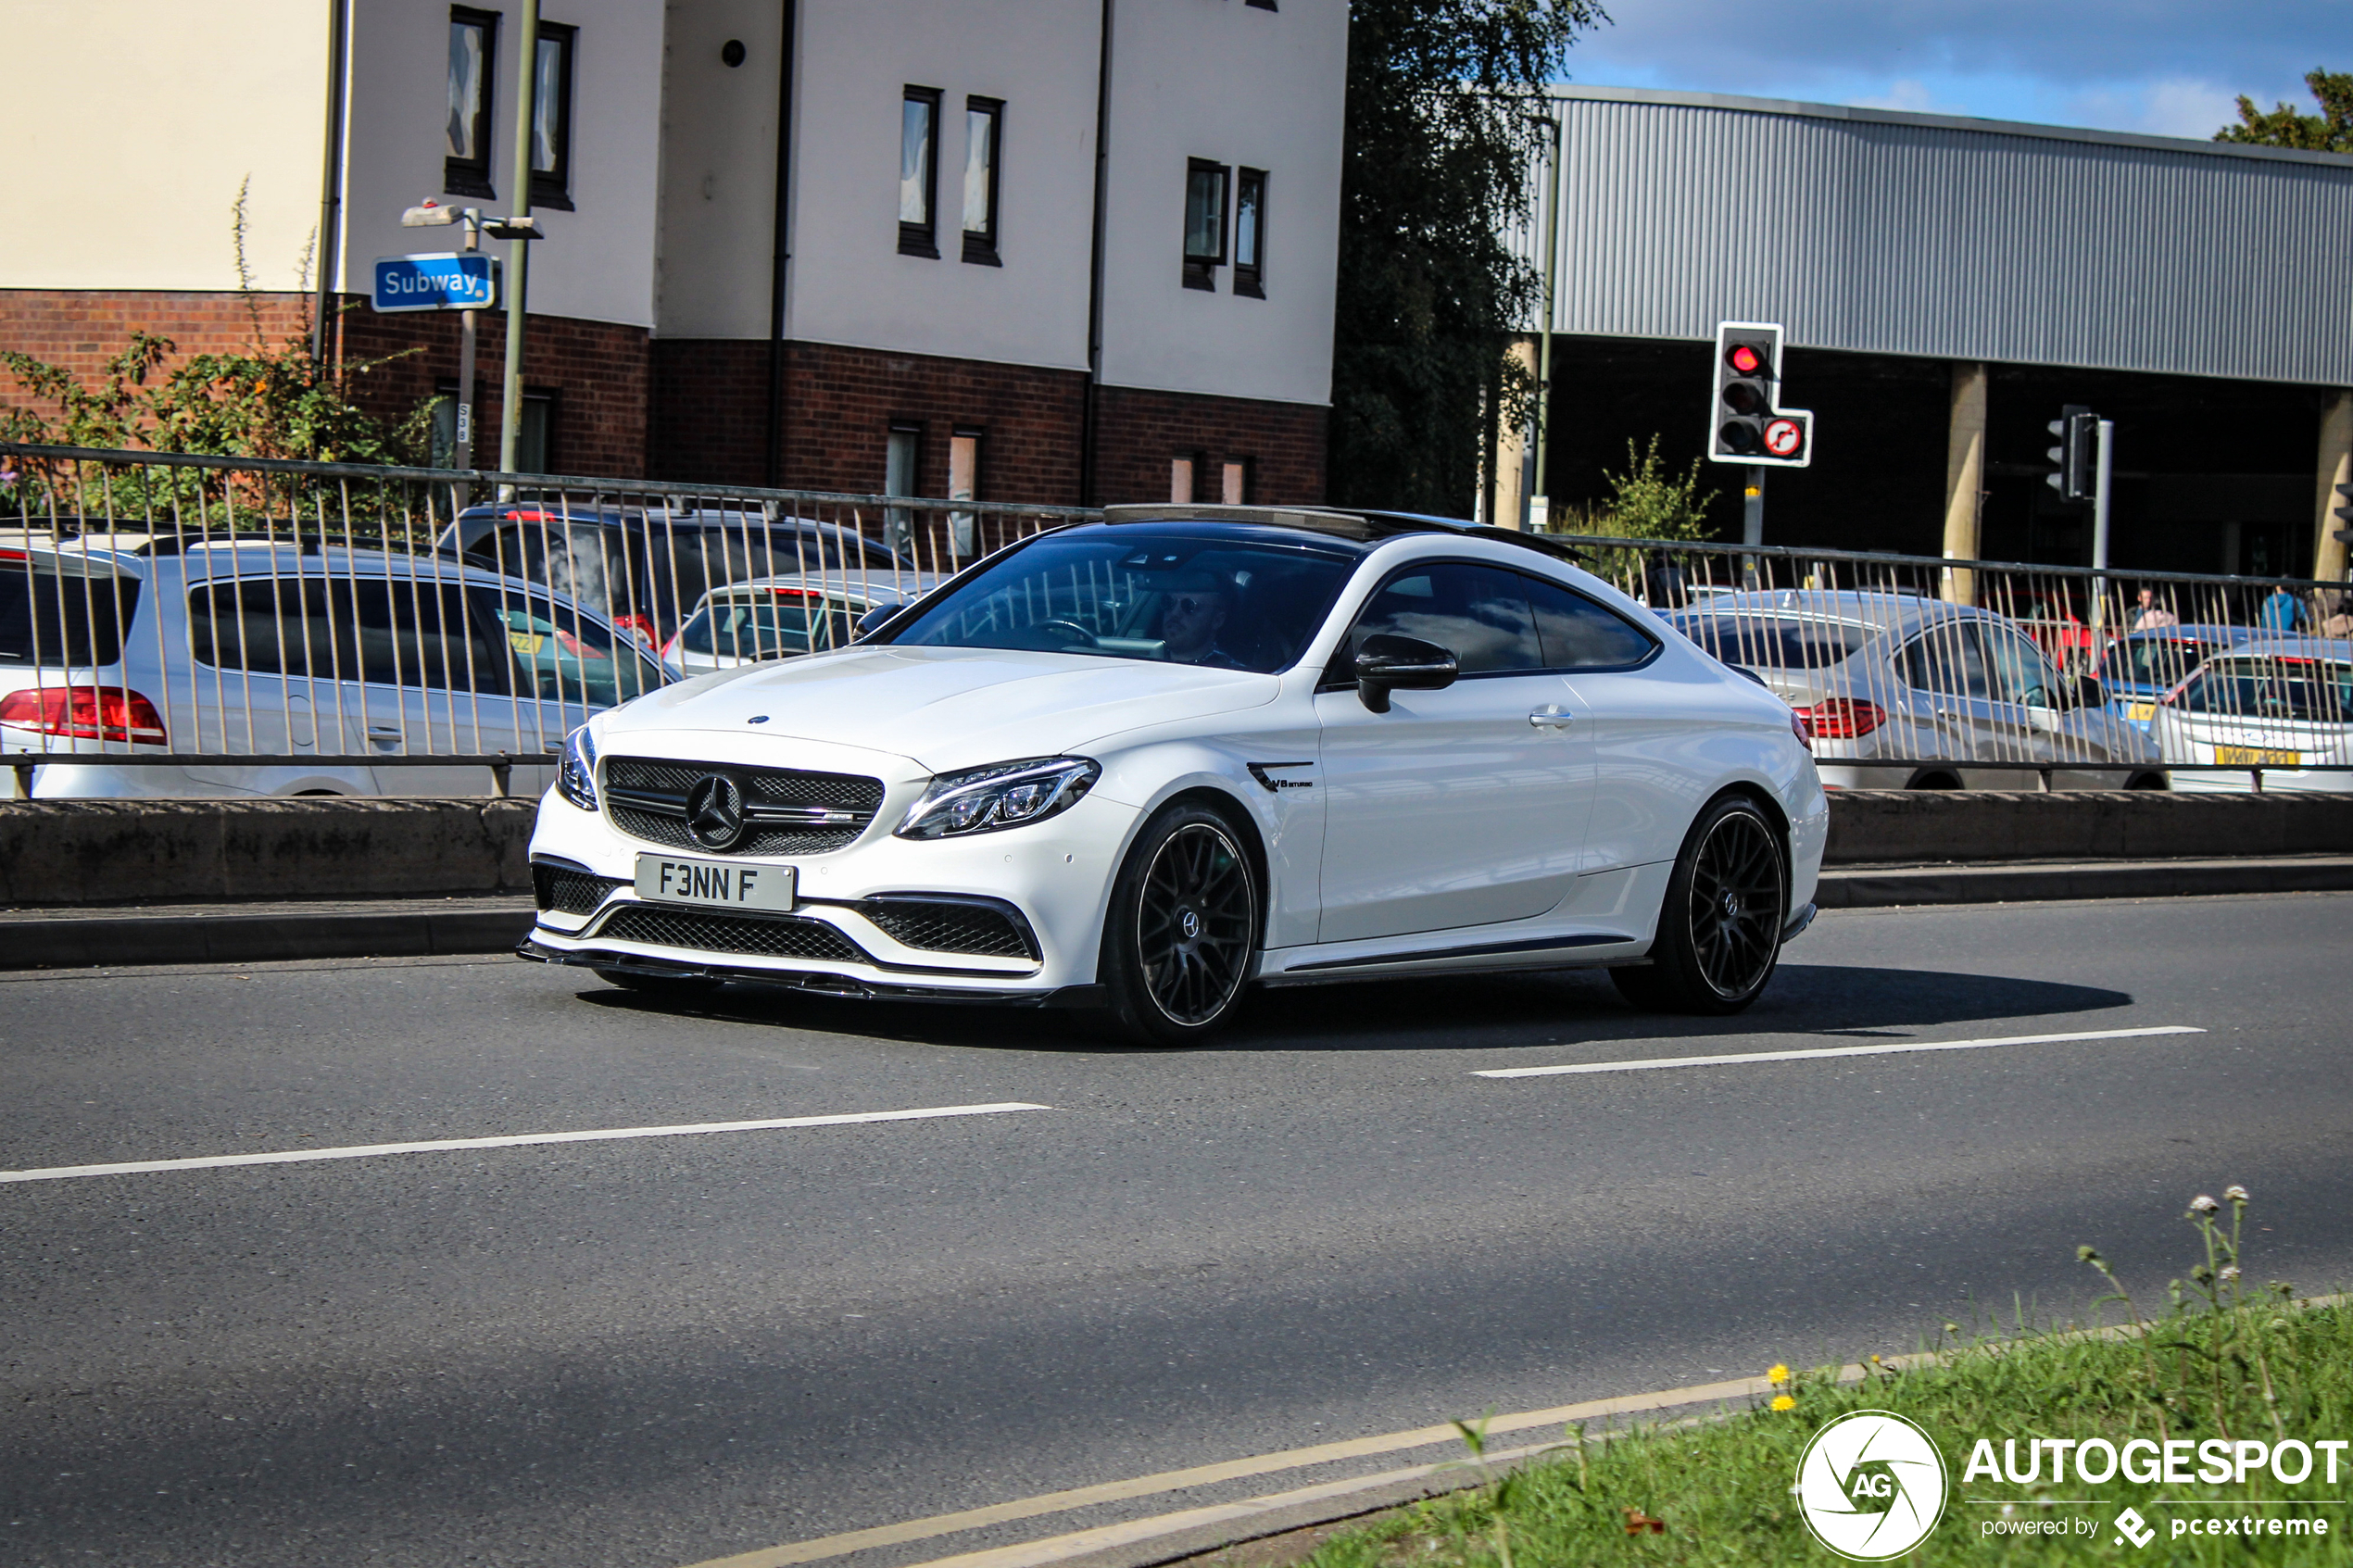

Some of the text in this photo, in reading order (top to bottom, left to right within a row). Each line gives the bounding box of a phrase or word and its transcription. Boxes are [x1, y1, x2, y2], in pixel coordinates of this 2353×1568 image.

[384, 270, 478, 295] Subway
[459, 405, 468, 441] S38
[1272, 779, 1289, 788] V8
[660, 861, 758, 901] F3NN F
